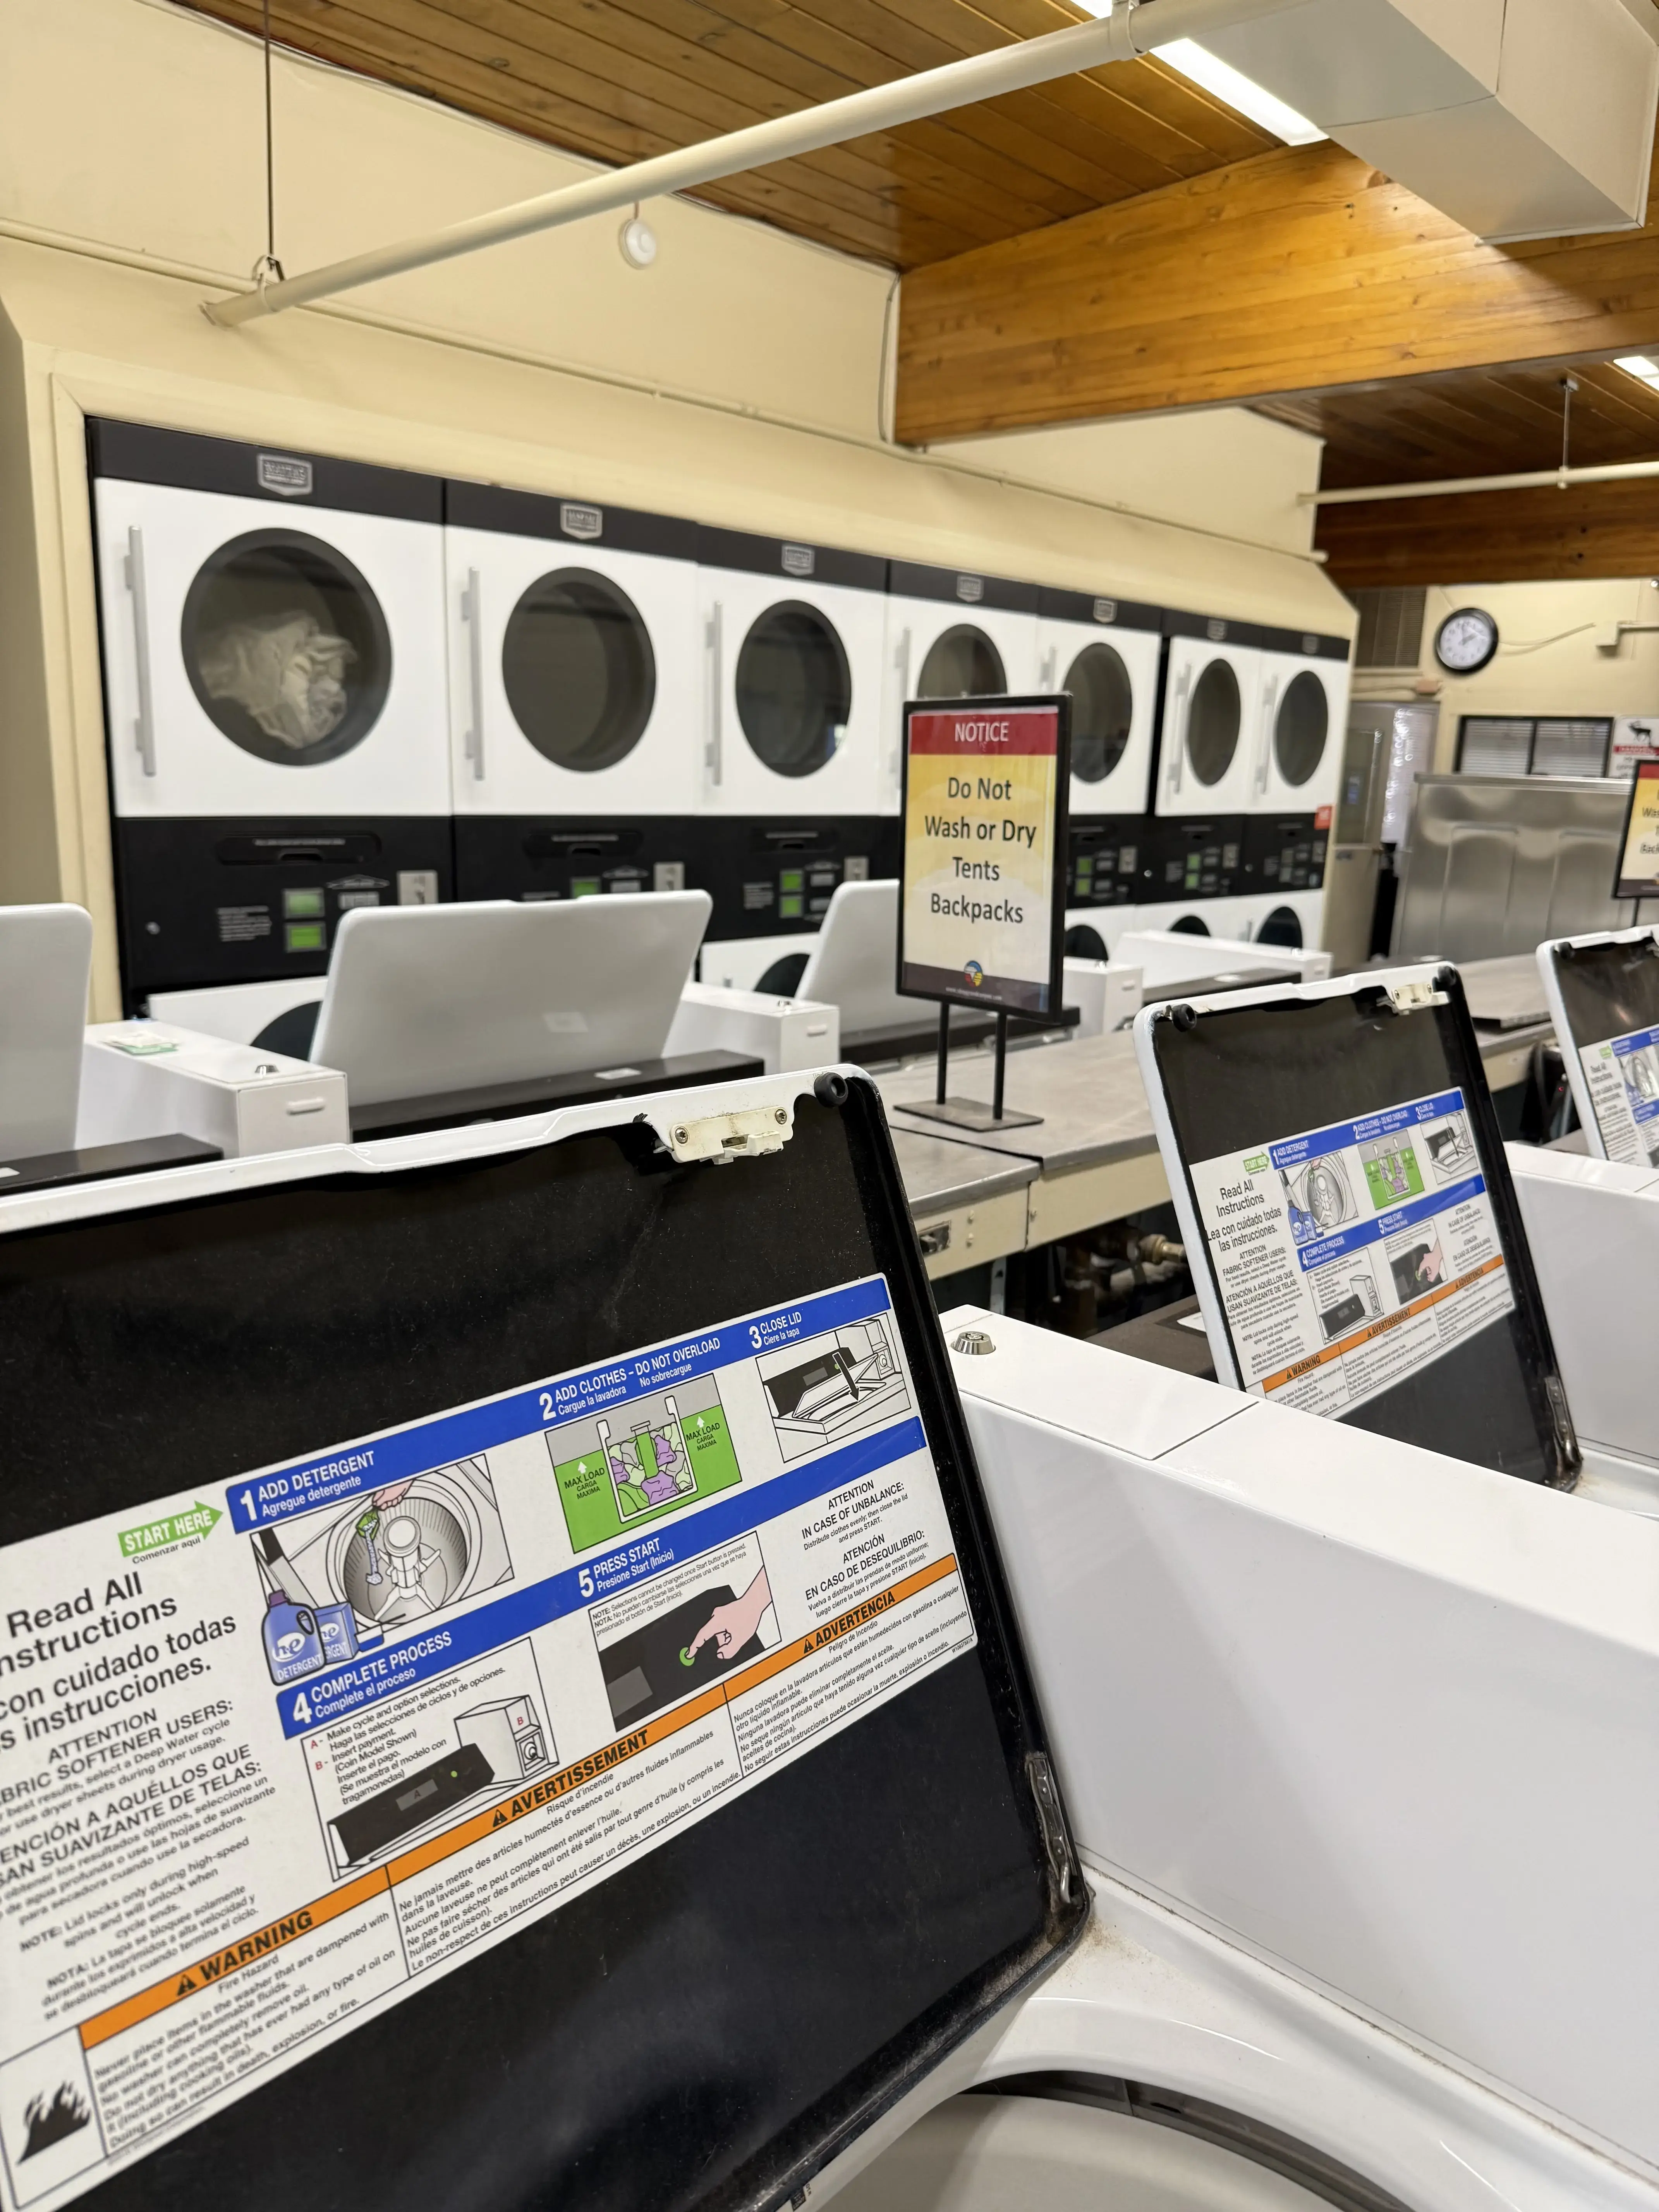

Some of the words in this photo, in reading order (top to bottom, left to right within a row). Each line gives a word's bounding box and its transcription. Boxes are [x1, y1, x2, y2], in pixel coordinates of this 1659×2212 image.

[955, 722, 1010, 742] NOTICE
[948, 777, 971, 799] Do
[977, 778, 1012, 800] Not
[925, 815, 970, 839] Wash
[977, 823, 996, 841] or
[1002, 819, 1037, 848] Dry
[953, 857, 1000, 881] Tents
[931, 893, 1024, 924] Backpacks
[1219, 1182, 1242, 1200] Read
[1243, 1179, 1254, 1192] All
[1216, 1194, 1264, 1217] Instructions
[1222, 1224, 1235, 1236] con
[1237, 1212, 1262, 1230] cuidado
[1263, 1207, 1281, 1221] todas
[1218, 1240, 1230, 1252] las
[1230, 1224, 1277, 1247] instrucciones.
[1240, 1244, 1266, 1259] ATTENTION
[1222, 1263, 1242, 1276] FABRIC
[1242, 1253, 1268, 1268] SOFTENER
[1268, 1247, 1286, 1258] USERS:
[1226, 1287, 1252, 1303] ATENCIÓN
[1258, 1274, 1283, 1290] AQUÉLLOS
[1283, 1270, 1293, 1279] QUE
[1227, 1301, 1242, 1312] USAN
[1243, 1288, 1273, 1306] SUAVIZANTE
[1274, 1285, 1281, 1293] DE
[1281, 1278, 1297, 1290] TELAS:
[749, 1326, 762, 1348] 3
[760, 1316, 788, 1334] CLOSE
[788, 1312, 801, 1325] LID
[764, 1334, 779, 1345] Ciere
[779, 1331, 786, 1340] la
[786, 1328, 799, 1338] tapa
[556, 1384, 577, 1403] ADD
[579, 1368, 626, 1393] CLOTHES
[635, 1360, 649, 1375] DO
[651, 1353, 670, 1370] NOT
[673, 1338, 720, 1362] OVERLOAD
[639, 1377, 650, 1387] No
[651, 1364, 691, 1383] sobrecargue
[1291, 1355, 1320, 1376] WARNING
[539, 1393, 556, 1420] 2
[558, 1400, 586, 1415] Cargue
[586, 1396, 594, 1405] la
[594, 1386, 626, 1402] lavadora
[686, 1429, 701, 1441] MAX
[702, 1422, 720, 1434] LOAD
[697, 1434, 714, 1444] CARGA
[697, 1439, 716, 1451] MAXIMA
[259, 1479, 288, 1502] ADD
[292, 1450, 373, 1490] DETERGENT
[564, 1475, 582, 1489] MAX
[583, 1467, 605, 1481] LOAD
[577, 1480, 597, 1491] CARGA
[240, 1490, 257, 1520] 1
[263, 1495, 305, 1516] Agregue
[307, 1476, 361, 1501] detergente
[577, 1486, 600, 1499] MAXIMA
[829, 1479, 874, 1510] ATTENTION
[802, 1526, 812, 1539] IN
[814, 1513, 837, 1532] CASE
[839, 1507, 850, 1520] OF
[852, 1482, 904, 1513] UNBALANCE:
[804, 1534, 829, 1550] Distribute
[831, 1524, 849, 1536] clothes
[850, 1515, 867, 1527] evenly;
[867, 1509, 878, 1517] then
[879, 1502, 892, 1511] close
[124, 1522, 170, 1551] START
[174, 1509, 212, 1535] HERE
[839, 1533, 848, 1542] and
[849, 1527, 863, 1539] press
[864, 1516, 882, 1529] START.
[132, 1544, 178, 1564] Comenzar
[181, 1536, 200, 1548] aquí
[593, 1553, 627, 1578] PRESS
[629, 1537, 659, 1562] START
[843, 1534, 884, 1564] ATENCIÓN
[597, 1571, 630, 1591] Presione
[631, 1560, 649, 1576] Start
[650, 1548, 674, 1569] (Inicio)
[805, 1585, 818, 1600] EN
[820, 1572, 844, 1591] CASO
[846, 1563, 859, 1578] DE
[860, 1530, 924, 1570] DESEQUILIBRIO:
[808, 1598, 826, 1611] Vuelva
[832, 1582, 854, 1598] distribuir
[864, 1566, 884, 1582] prendas
[892, 1554, 905, 1565] modo
[906, 1542, 928, 1557] uniforme;
[579, 1568, 594, 1597] 5
[816, 1606, 831, 1618] luego
[832, 1597, 847, 1608] cierre
[854, 1587, 865, 1596] tapa
[870, 1573, 891, 1589] presione
[891, 1561, 907, 1575] START
[909, 1553, 926, 1567] (Inicio).
[7, 1588, 93, 1638] Read
[105, 1571, 142, 1606] All
[816, 1591, 895, 1647] ADVERTENCIA
[829, 1638, 847, 1653] Peligro
[855, 1621, 877, 1637] Incendio
[53, 1644, 159, 1697] cuidado
[165, 1616, 235, 1654] todas
[276, 1652, 323, 1682] DETERGENT
[311, 1658, 388, 1702] COMPLETE
[389, 1631, 451, 1669] PROCESS
[23, 1657, 211, 1740] instrucciones.
[293, 1692, 312, 1723] 4
[315, 1690, 364, 1717] Complete
[366, 1682, 375, 1696] el
[376, 1668, 415, 1694] proceso
[326, 1726, 351, 1740] Make
[353, 1715, 374, 1729] cycle
[376, 1705, 392, 1719] and
[393, 1695, 418, 1711] option
[420, 1677, 460, 1698] selections.
[48, 1708, 156, 1763] ATTENTION
[0, 1772, 51, 1809] BRIC
[57, 1727, 161, 1780] SOFTENER
[166, 1700, 232, 1734] USERS:
[88, 1811, 100, 1827] A
[106, 1764, 208, 1818] AQUÉLLOS
[212, 1744, 251, 1770] QUE
[512, 1729, 647, 1817] AVERTISSEMENT
[546, 1796, 573, 1814] Risque
[575, 1774, 613, 1798] d'incendie
[40, 1802, 164, 1867] SUAVIZANTE
[169, 1788, 195, 1810] DE
[199, 1762, 261, 1795] TELAS:
[199, 1911, 313, 1980] WARNING
